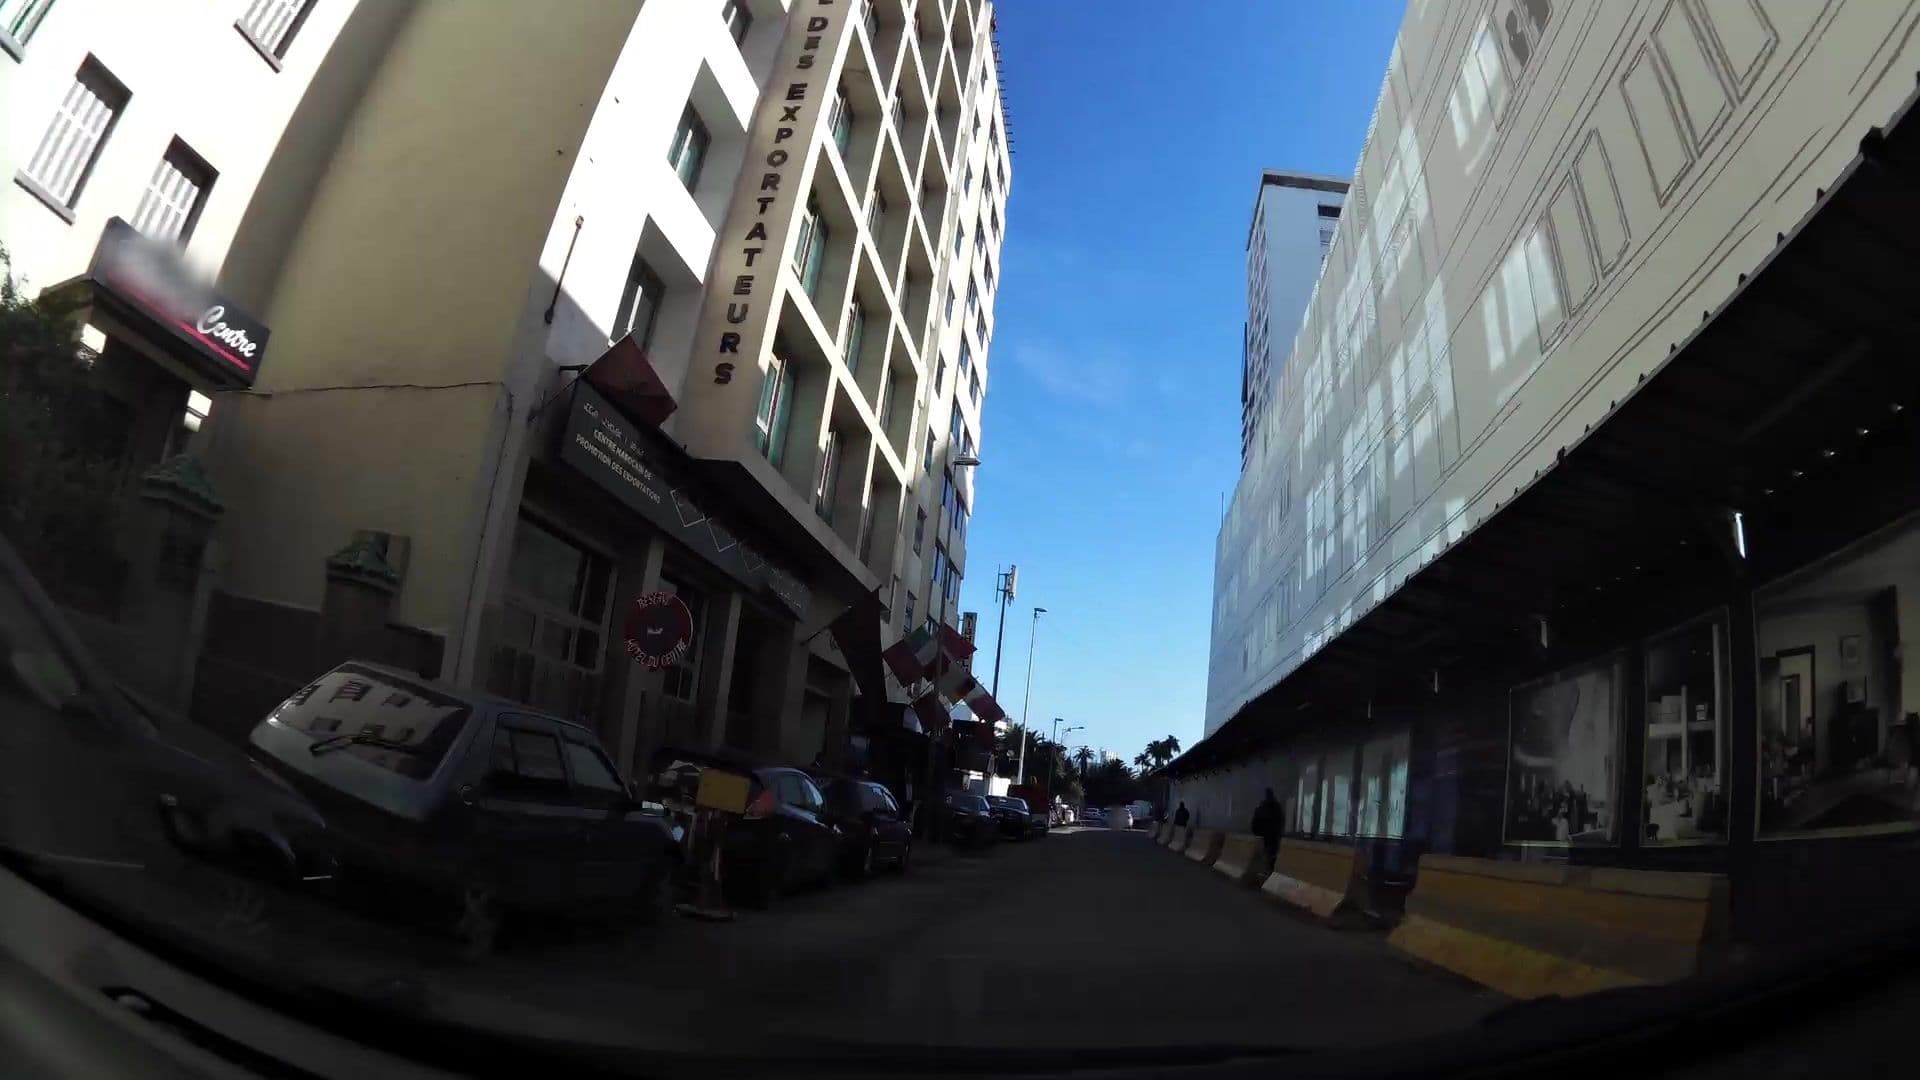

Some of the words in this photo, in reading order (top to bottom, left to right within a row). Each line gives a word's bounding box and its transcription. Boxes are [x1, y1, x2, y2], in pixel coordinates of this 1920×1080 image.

[796, 16, 828, 69] DES
[714, 83, 808, 385] EXPORTATEURS
[197, 305, 256, 357] Centre
[576, 434, 612, 466] PROMOTION
[611, 461, 623, 476] DES
[622, 470, 661, 504] EXPORTATIONS
[594, 429, 616, 452] CENTRE
[616, 447, 644, 475] MAROCAIN
